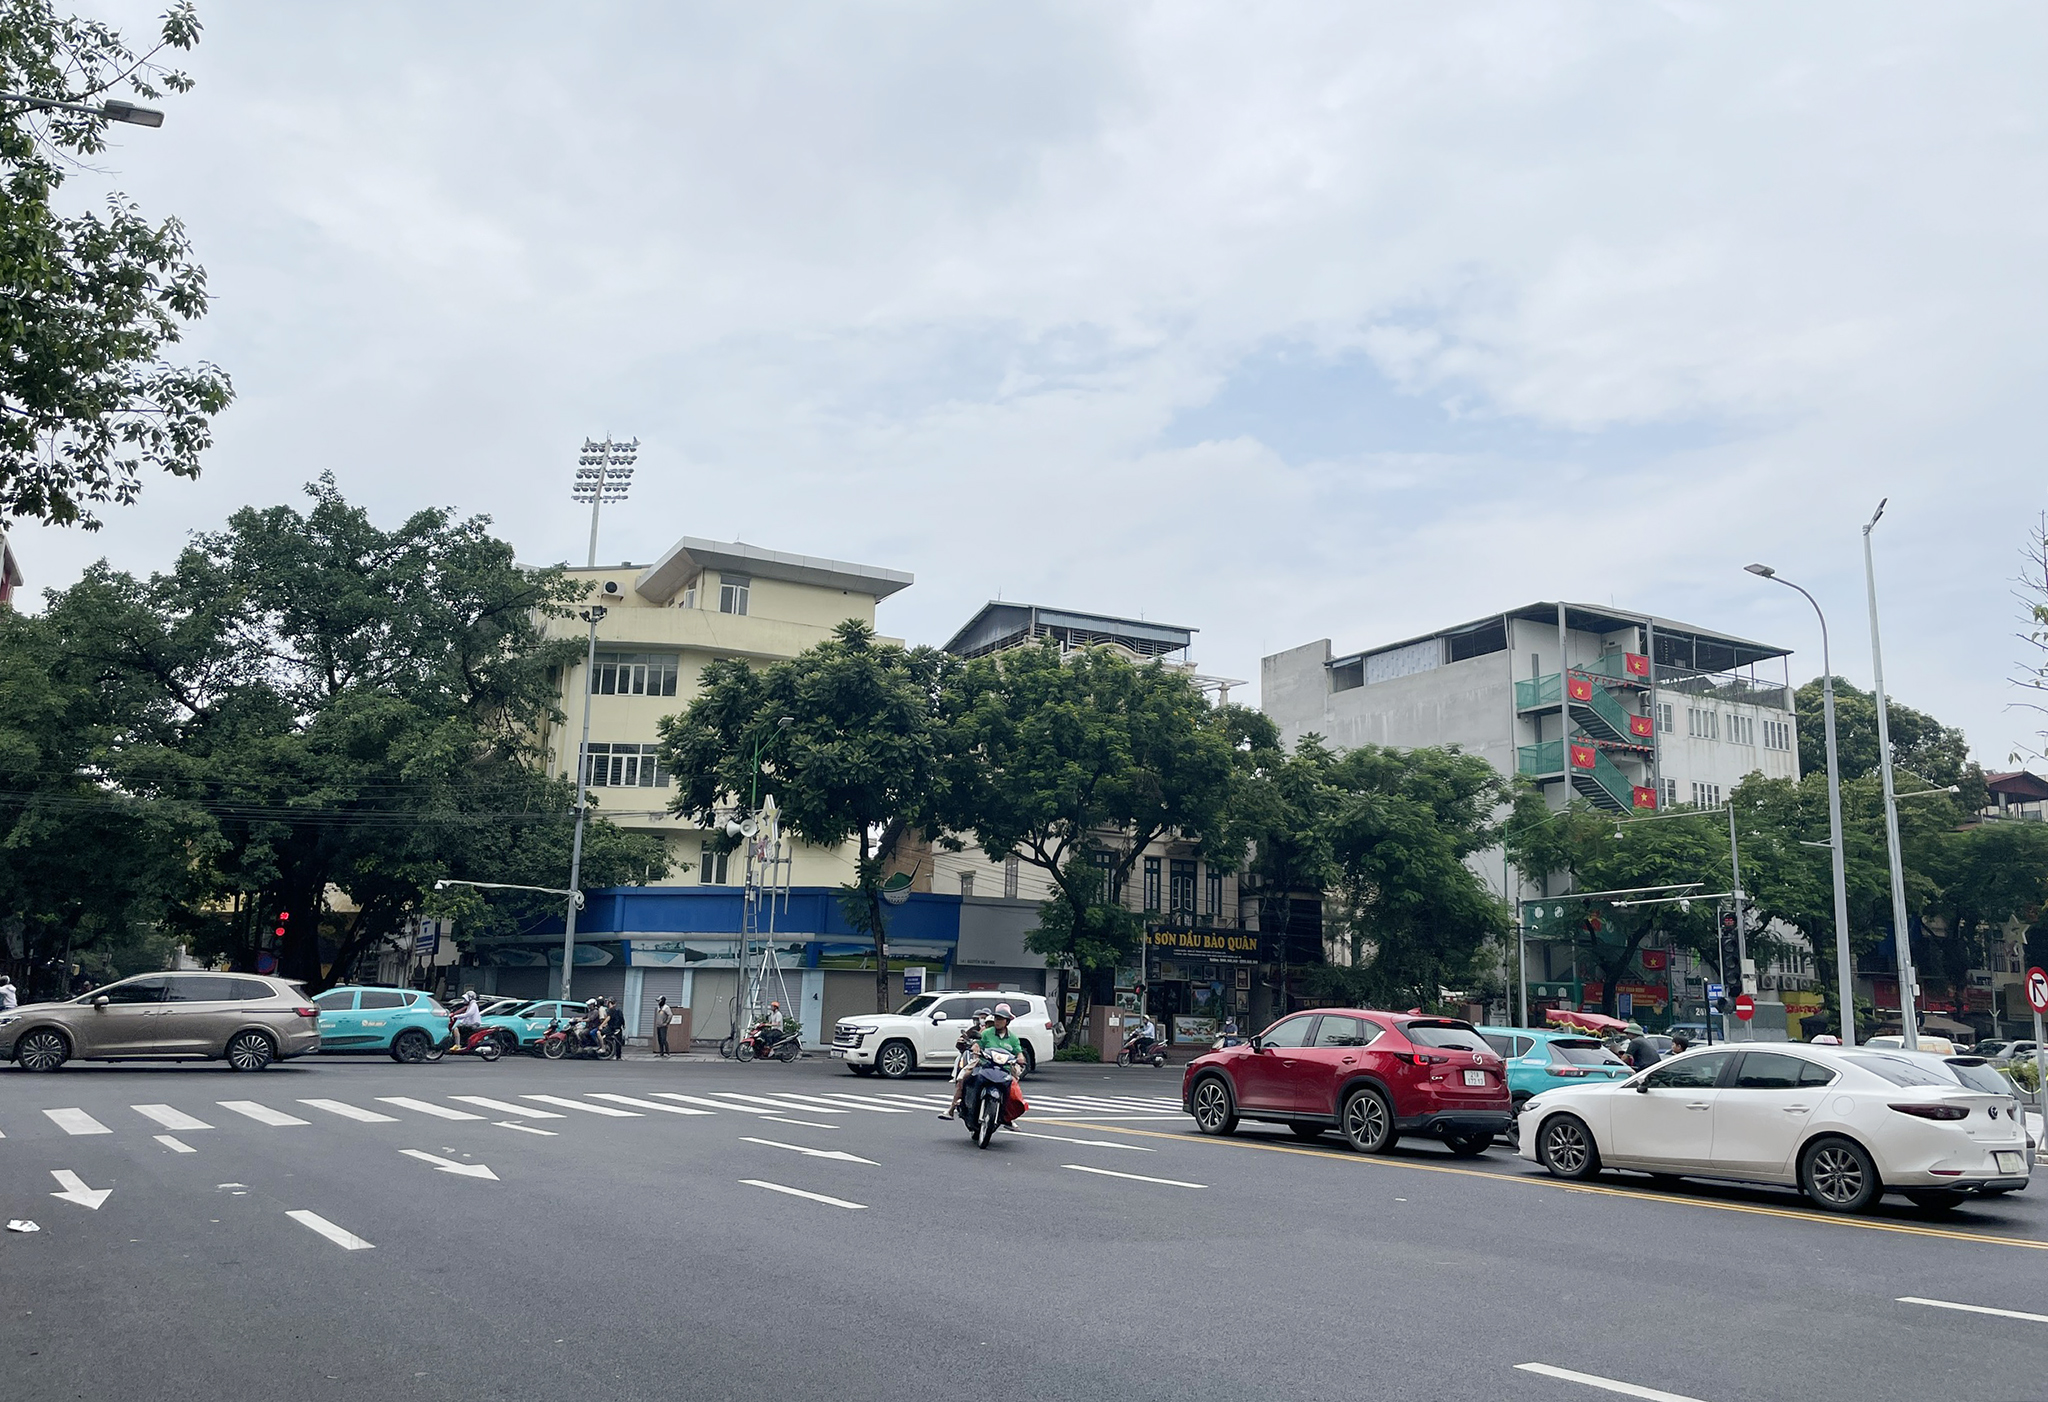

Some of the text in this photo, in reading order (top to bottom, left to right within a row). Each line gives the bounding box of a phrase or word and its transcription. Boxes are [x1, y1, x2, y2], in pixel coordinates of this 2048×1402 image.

[1154, 931, 1177, 946] SƠN
[1179, 930, 1201, 947] DẦU
[1203, 932, 1225, 949] BẢO
[1227, 935, 1258, 951] QUÂN
[812, 992, 818, 1001] 4
